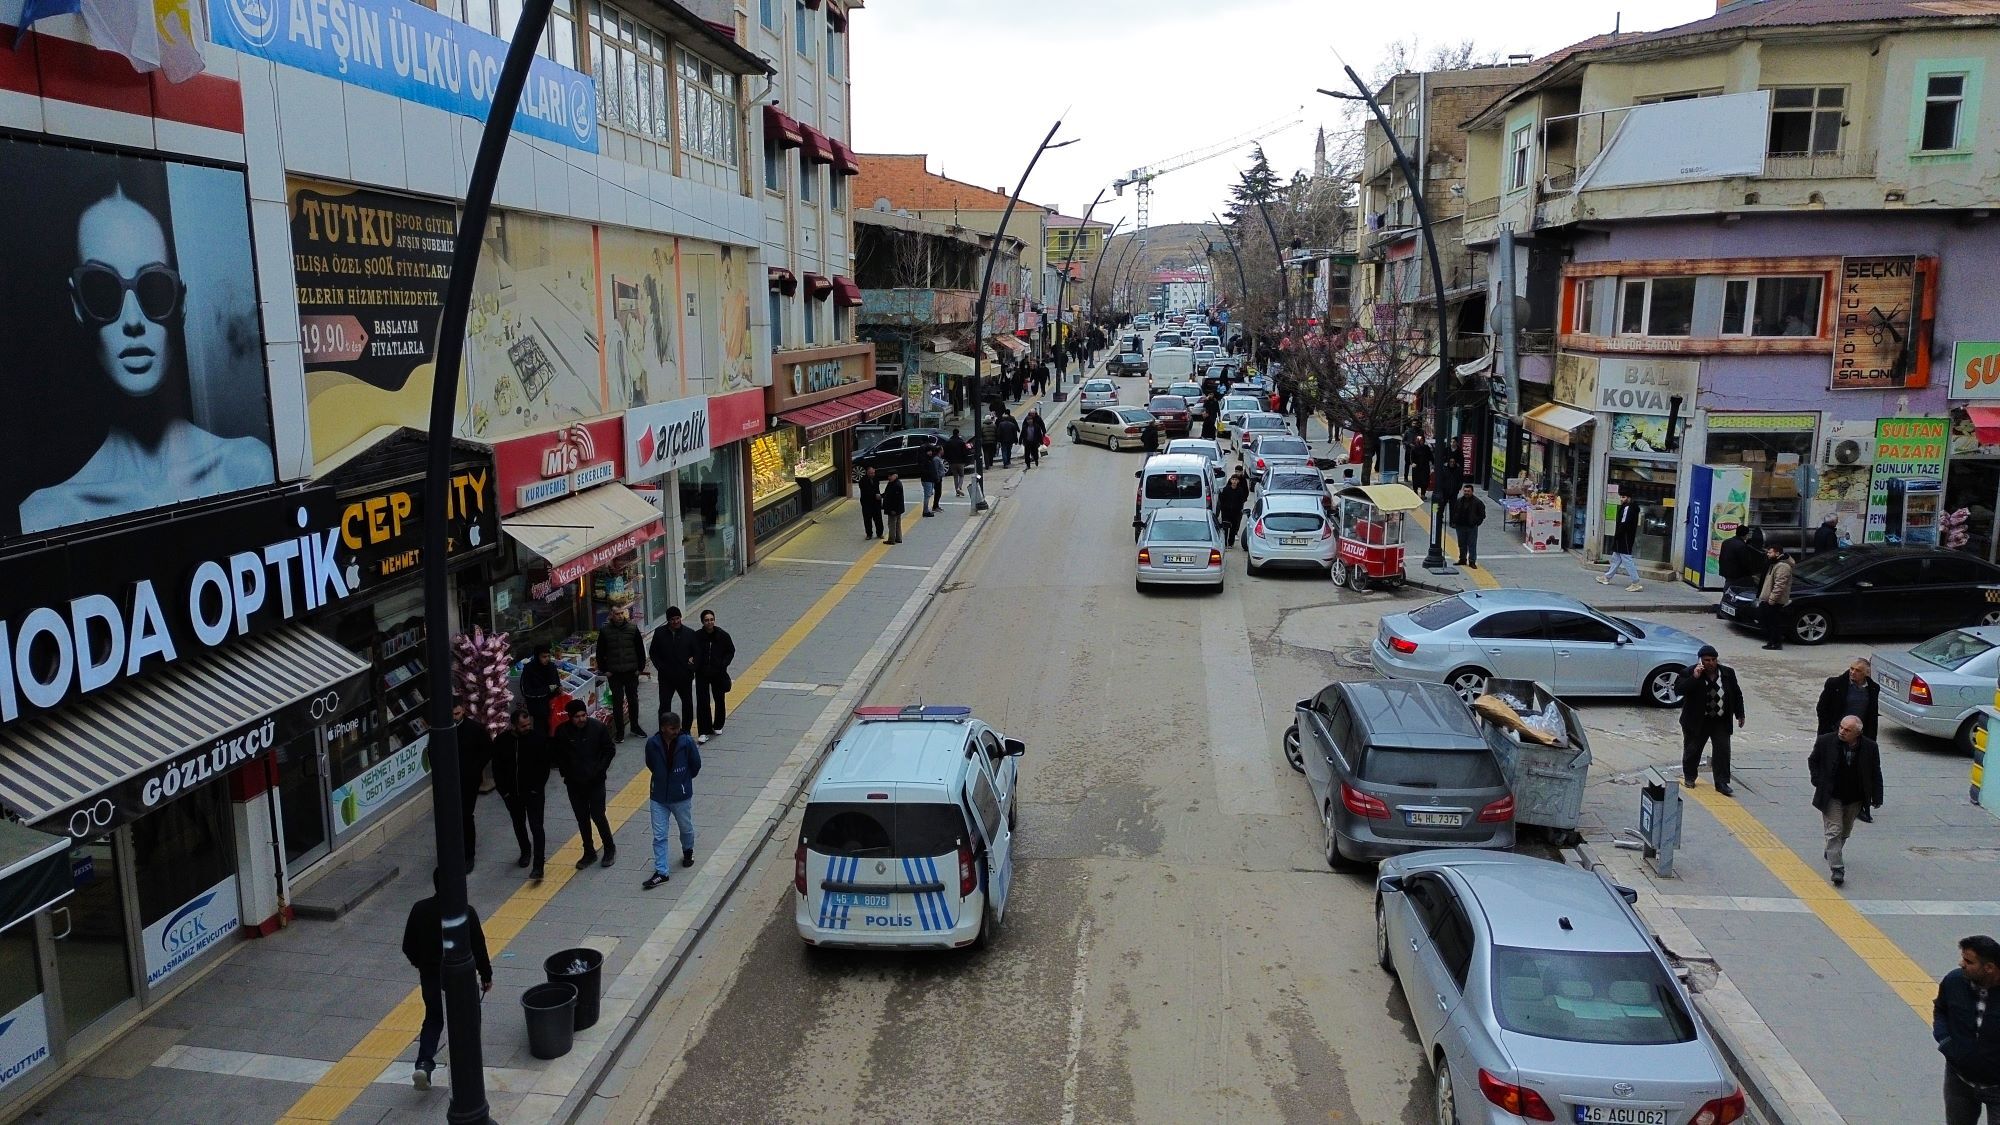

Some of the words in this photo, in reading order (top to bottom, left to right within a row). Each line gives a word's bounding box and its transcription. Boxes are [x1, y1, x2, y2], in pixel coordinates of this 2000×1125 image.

[388, 7, 460, 94] ÜLKÜ
[302, 198, 393, 247] TUTKU
[395, 214, 422, 231] SPOR
[425, 215, 454, 235] GİYİM
[396, 234, 420, 252] AFŞİN
[422, 236, 454, 254] ŞUBEMİZ
[332, 253, 361, 275] ÖZEL
[364, 255, 395, 278] ŞOOK
[396, 257, 452, 280] FİYATLARL
[1846, 259, 1912, 280] SEÇKİN
[302, 323, 345, 354] 19.90
[373, 320, 419, 337] BAŞLAYAN
[370, 341, 425, 357] FİYATLARLA
[1624, 365, 1670, 386] BAL
[1838, 369, 1897, 380] SALON
[655, 409, 706, 466] arçelik
[1881, 422, 1944, 438] SULTAN
[1878, 442, 1941, 459] PAZARI
[1916, 463, 1940, 475] TAZE
[341, 491, 412, 550] CEP
[447, 467, 488, 521] ITY
[1691, 500, 1701, 551] pepsi
[1718, 522, 1739, 531] Lipton
[1342, 541, 1366, 557] TATLICI
[381, 549, 420, 576] MEHMET
[189, 505, 350, 647] OPTİK
[334, 718, 359, 738] iPhone
[142, 718, 277, 807] GÖZLÜKÇÜ
[361, 761, 393, 790] MEHMET
[396, 744, 419, 767] YILDIZ
[1411, 812, 1423, 825] 34
[1425, 813, 1436, 825] HL
[1438, 813, 1461, 826] 7375
[853, 895, 859, 905] A
[865, 912, 913, 927] POLİS
[169, 912, 208, 952] SGK
[148, 946, 196, 984] ANLAŞMAMIZ
[196, 917, 238, 951] MEVCUTTUR
[1584, 1105, 1601, 1121] 46
[1608, 1108, 1635, 1123] AGU
[1637, 1109, 1663, 1125] 062
